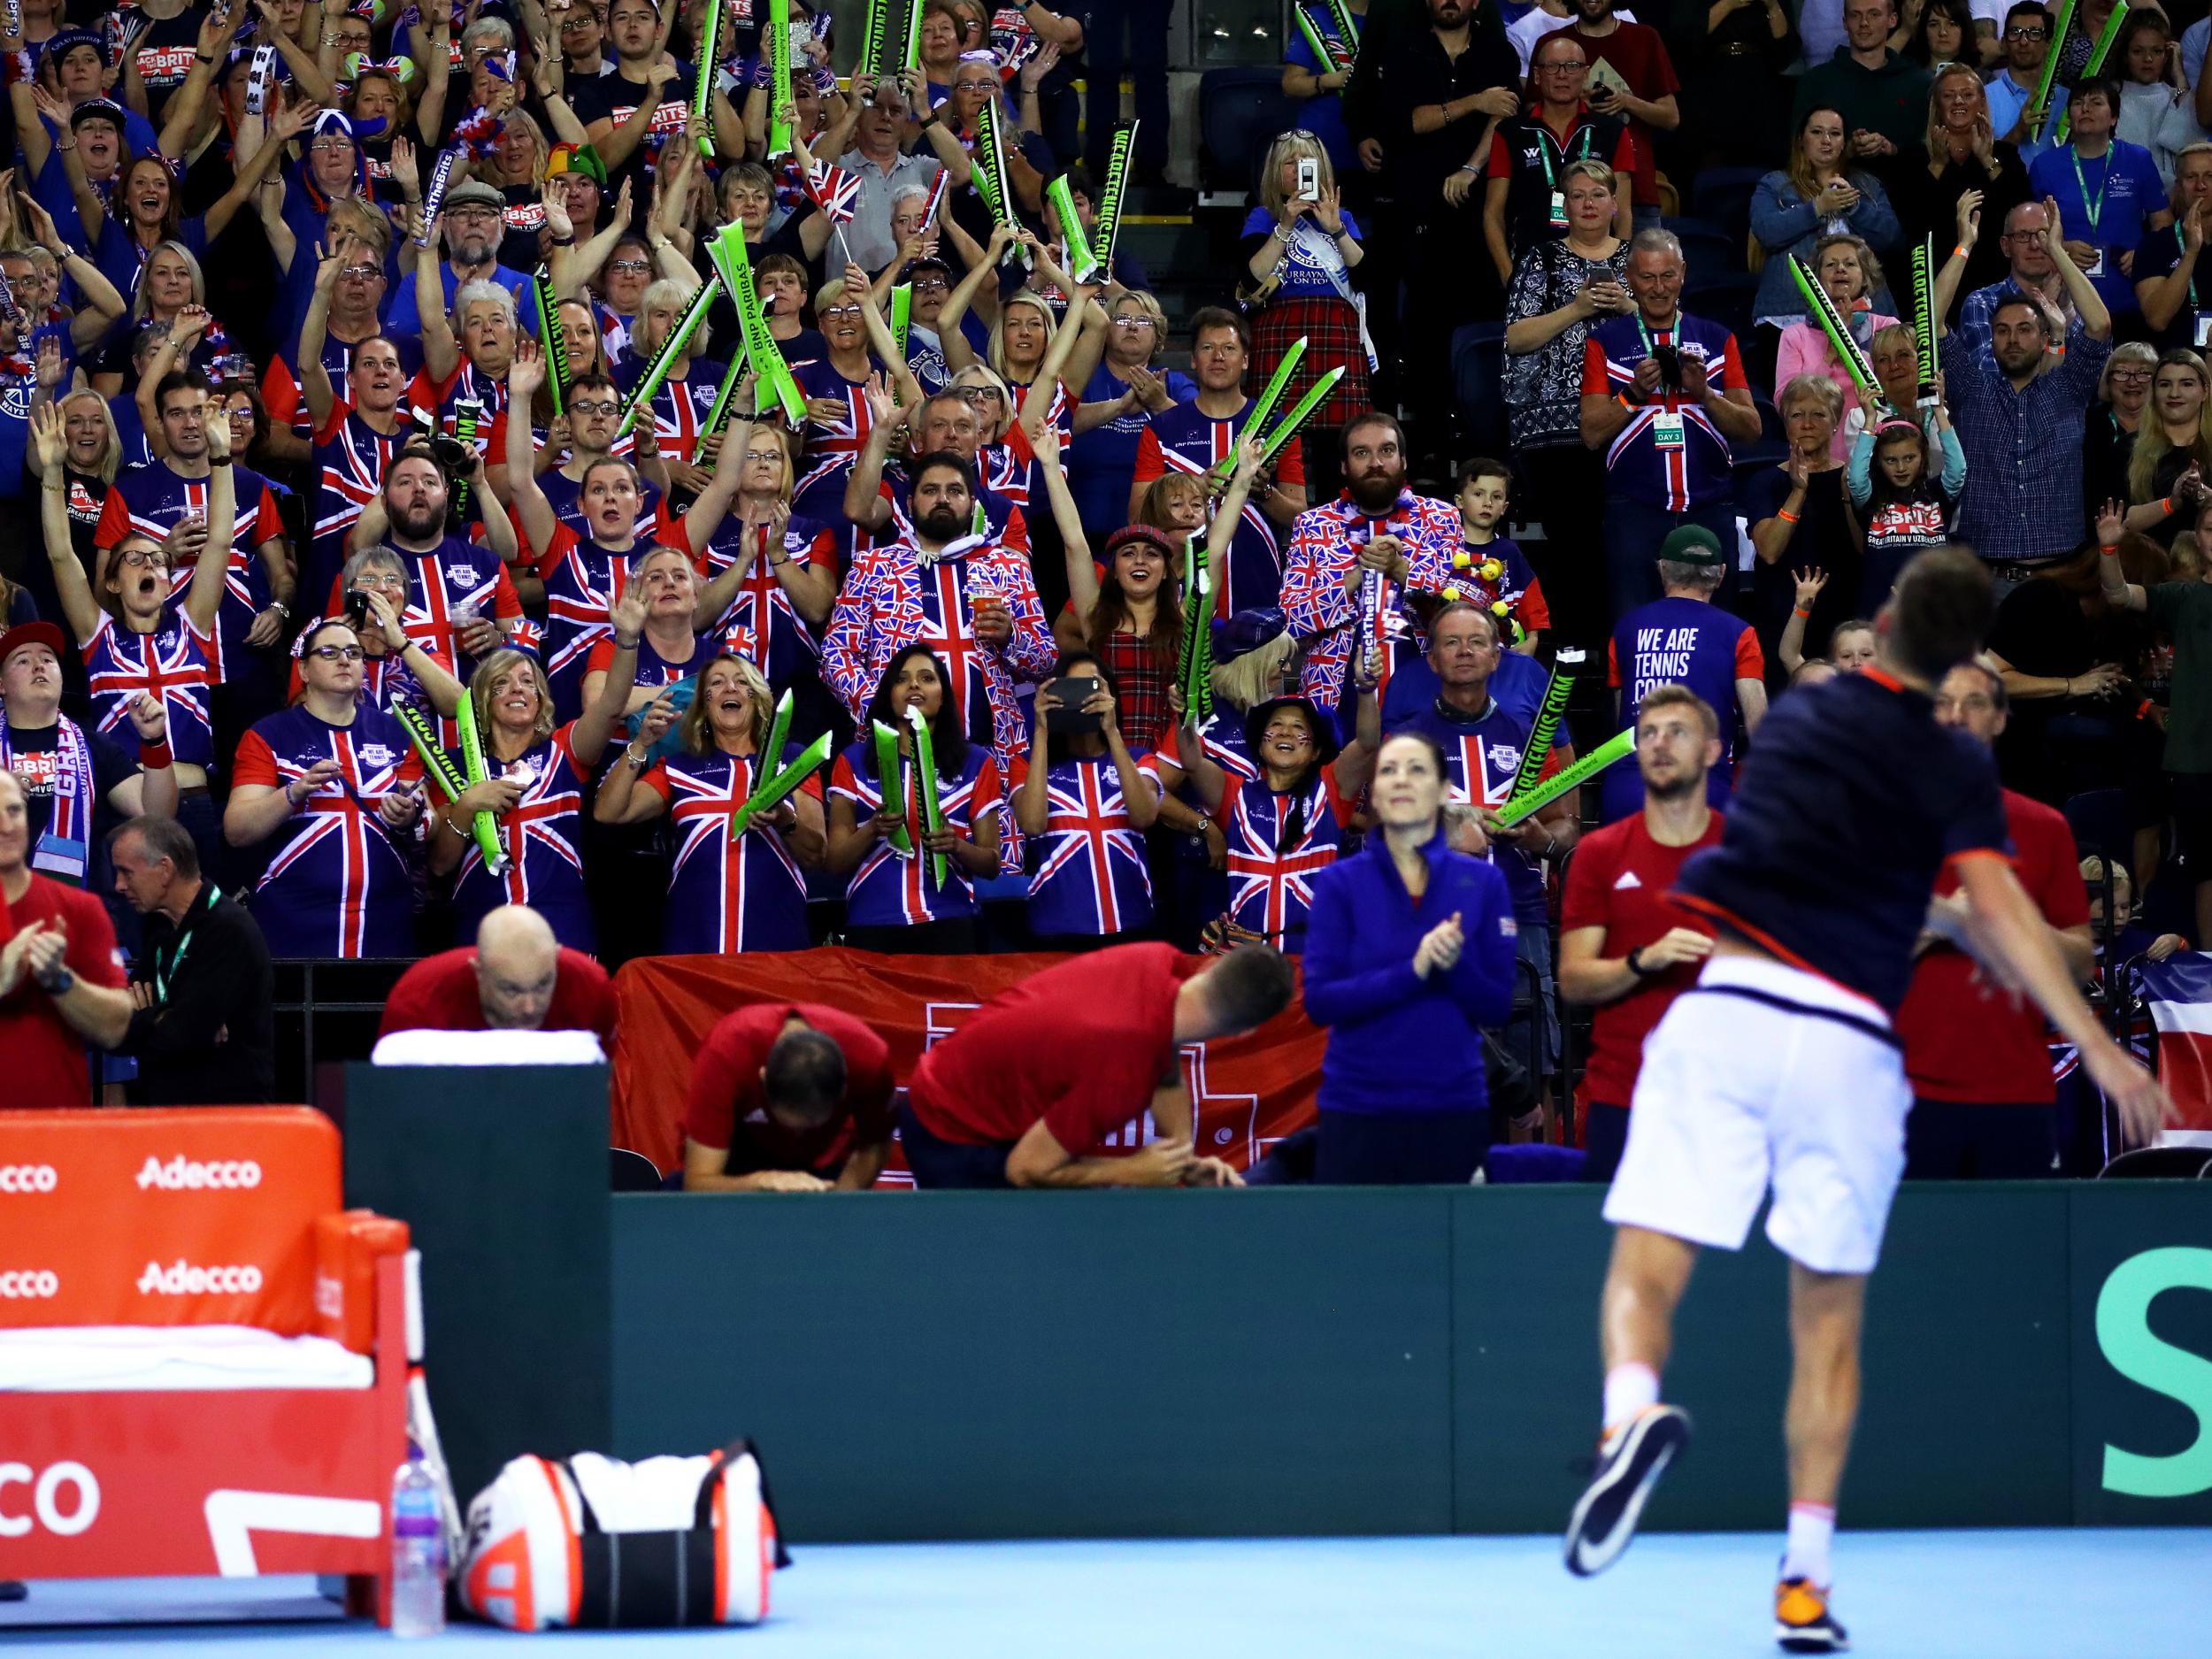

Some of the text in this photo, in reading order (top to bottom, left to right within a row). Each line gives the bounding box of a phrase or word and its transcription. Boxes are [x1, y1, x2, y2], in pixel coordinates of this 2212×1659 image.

[156, 53, 195, 67] BRIT
[651, 105, 688, 125] RITS
[505, 209, 546, 220] BRIT
[736, 262, 764, 351] BNP PARIBAS
[543, 281, 572, 386] WEARETENNI
[66, 506, 100, 522] GREAT BRIT
[1637, 627, 1700, 652] WE ARE
[1634, 652, 1691, 678] TENNIS
[55, 713, 78, 797] GREA
[406, 707, 466, 795] ENNIS.COM
[1515, 675, 1577, 802] ARETENNIS.COM
[1522, 798, 1533, 807] The
[1558, 768, 1584, 783] changing
[135, 1155, 262, 1190] Adecco
[137, 1258, 263, 1294] Adecco
